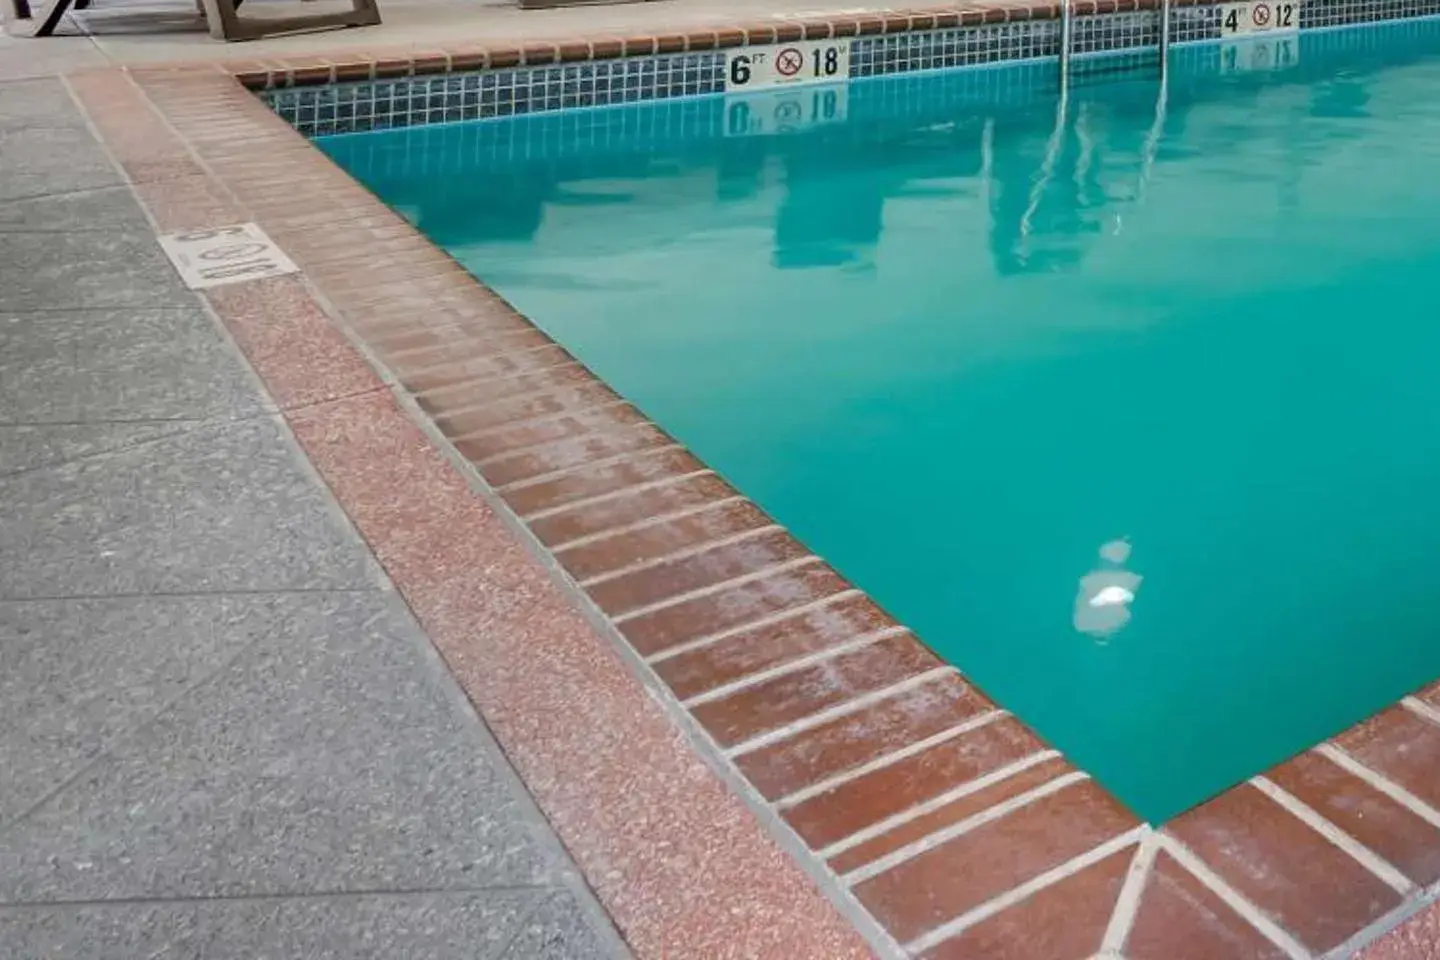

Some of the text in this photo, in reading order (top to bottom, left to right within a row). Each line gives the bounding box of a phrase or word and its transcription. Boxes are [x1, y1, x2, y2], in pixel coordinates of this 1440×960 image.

[1225, 9, 1238, 32] 4
[731, 54, 751, 85] 6
[752, 53, 765, 64] FT
